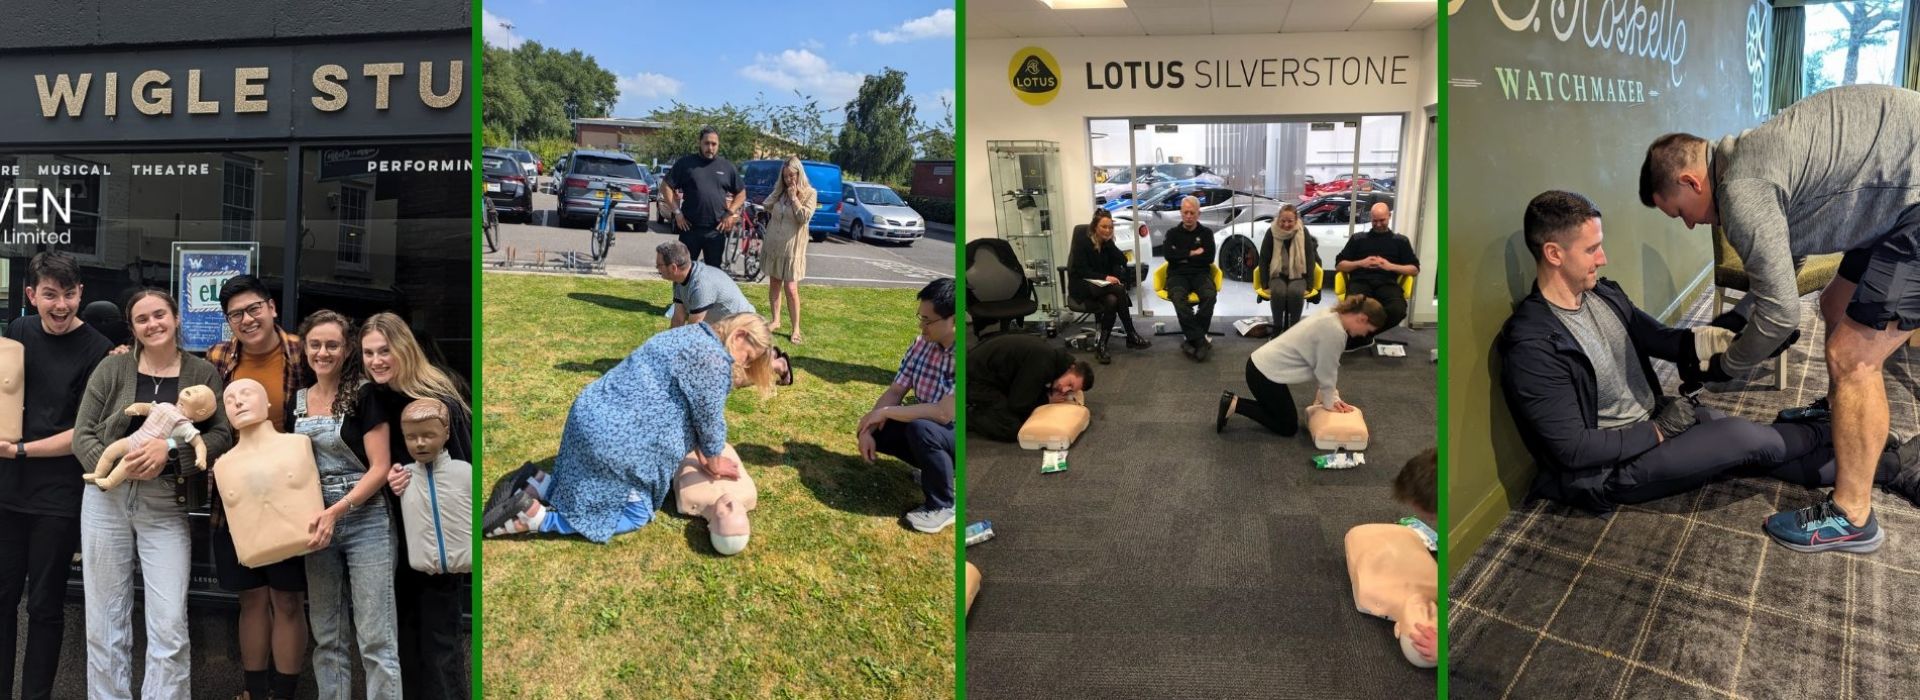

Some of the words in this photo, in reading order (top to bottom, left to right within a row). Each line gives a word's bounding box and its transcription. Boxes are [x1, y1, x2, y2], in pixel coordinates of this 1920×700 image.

[1016, 77, 1055, 87] LOTUS
[1086, 61, 1184, 90] LOTUS
[1195, 56, 1410, 88] SILVERSTONE
[1495, 67, 1645, 102] WATCHMAKER
[34, 66, 269, 117] WIGLE
[311, 60, 464, 112] STU
[38, 164, 111, 176] MUSICAL
[131, 163, 209, 176] THEATRE
[4, 228, 71, 245] Limited
